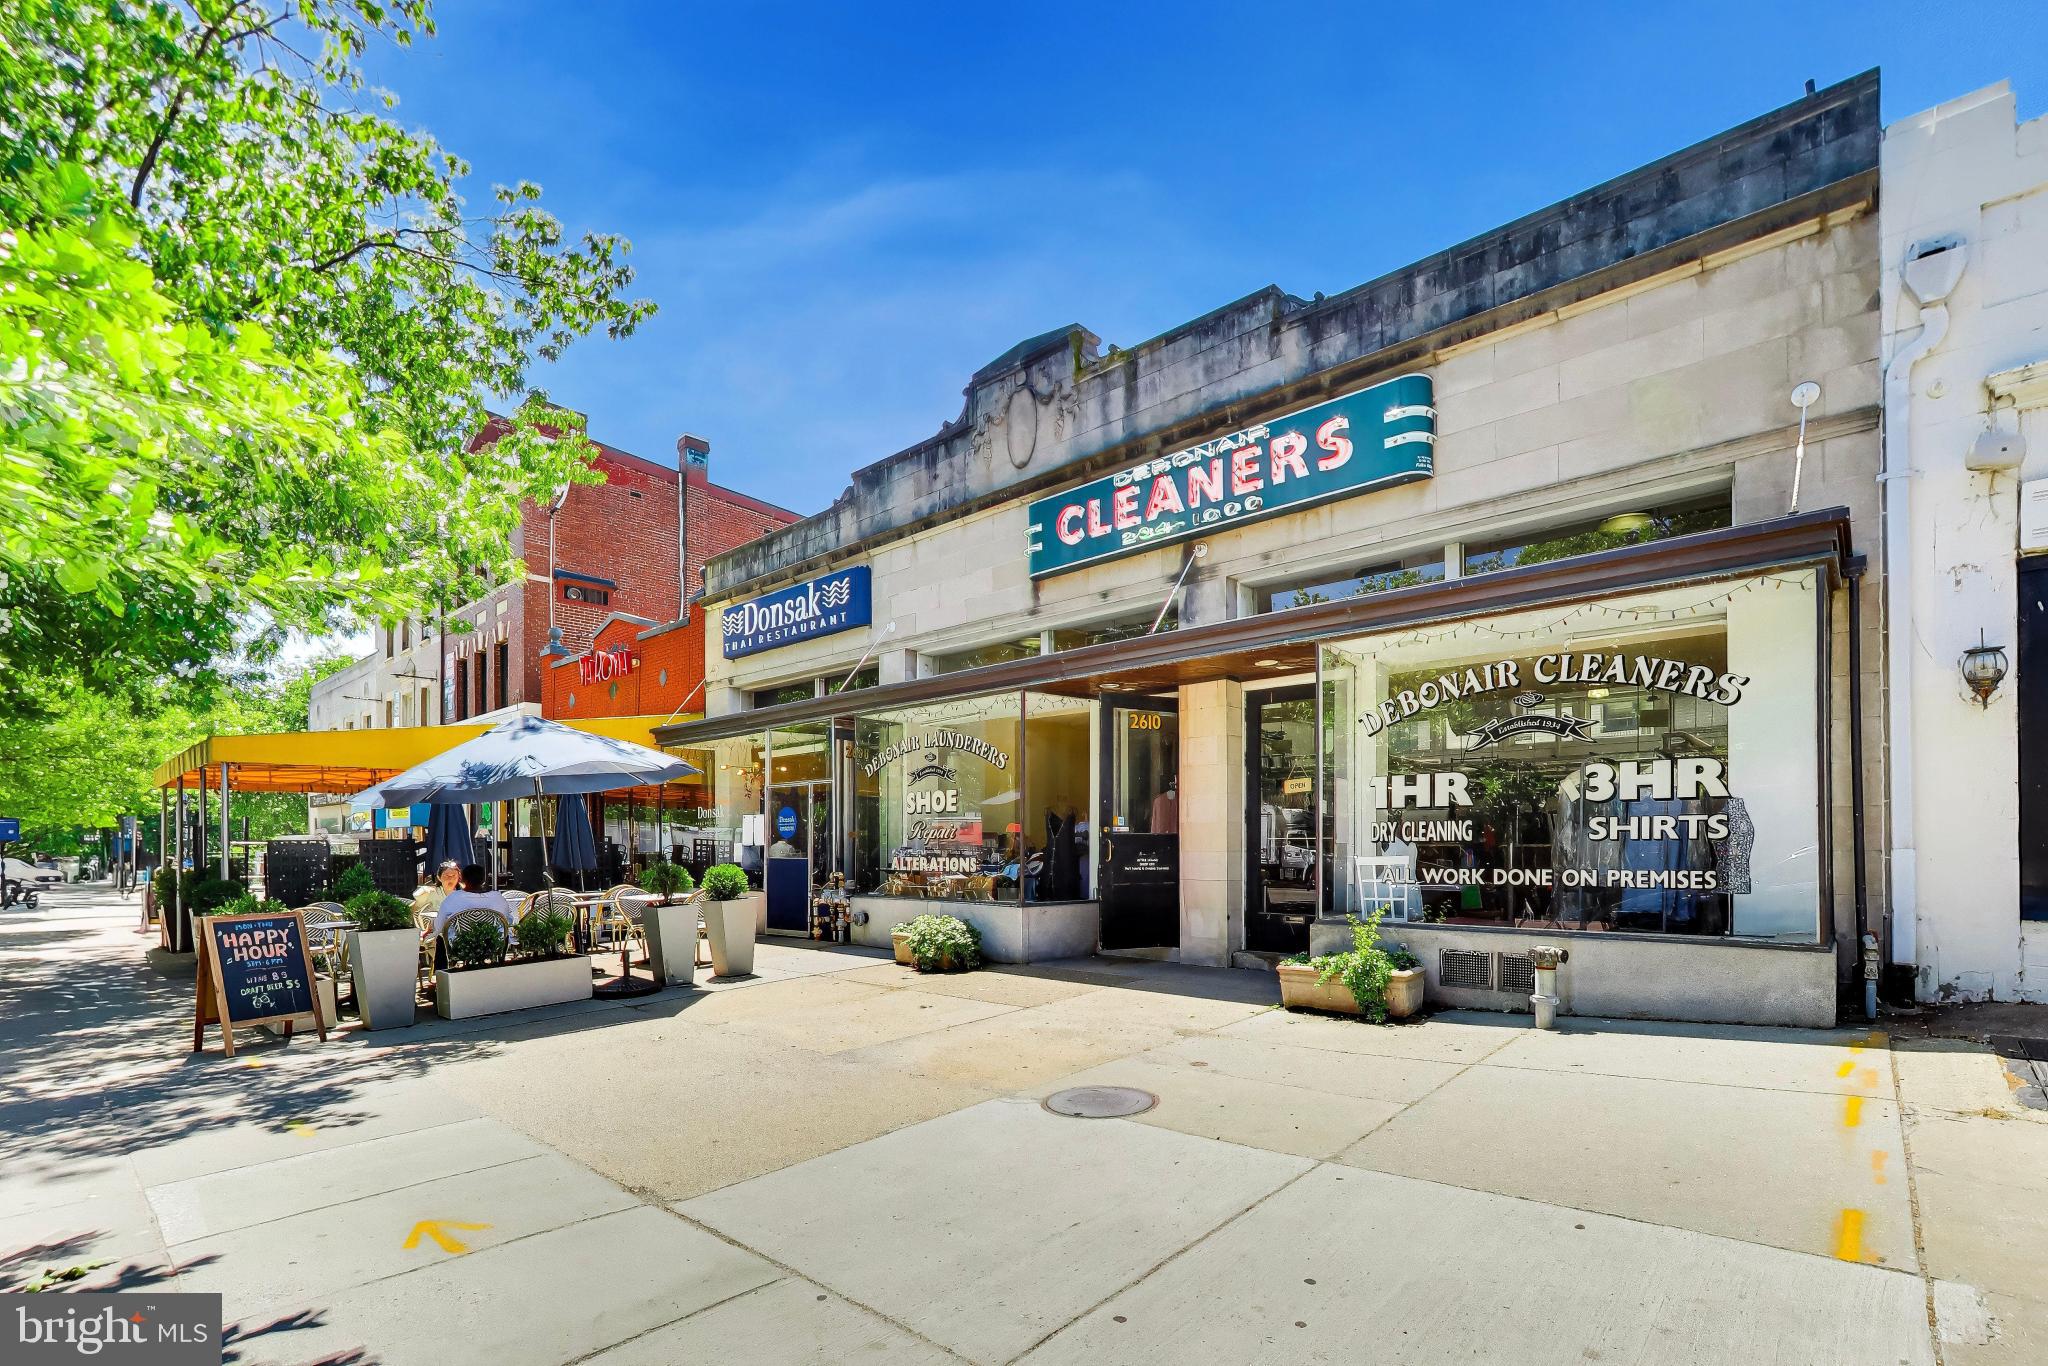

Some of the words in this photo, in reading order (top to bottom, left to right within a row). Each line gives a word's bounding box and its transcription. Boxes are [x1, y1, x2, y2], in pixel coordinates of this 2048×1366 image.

[1055, 415, 1354, 546] CLEANERS
[743, 582, 822, 636] Donsak
[725, 637, 752, 652] THAI
[758, 612, 847, 644] RESTAURANT
[1357, 659, 1520, 738] DEBONAIR
[1533, 653, 1751, 706] CLEANERS
[1129, 713, 1161, 730] 2610
[1498, 718, 1541, 734] Established
[864, 733, 921, 778] DEBONAIR
[923, 731, 1009, 770] LAUNDERERS
[1289, 782, 1306, 790] OPEN
[1369, 772, 1474, 809] 1HR
[1584, 757, 1732, 802] 3HR
[906, 789, 959, 815] SHOE
[907, 820, 958, 845] Repair
[1371, 821, 1398, 843] DRY
[1401, 820, 1474, 843] CLEANING
[1588, 814, 1730, 841] SHIRTS
[891, 855, 978, 873] ALTERATIONS
[1382, 866, 1416, 885] ALL
[1422, 867, 1486, 886] WORK
[1492, 868, 1554, 887] DONE
[1561, 868, 1600, 888] ON
[1606, 869, 1718, 890] PREMISES
[222, 929, 289, 948] HAPPY
[233, 943, 288, 962] HOUR
